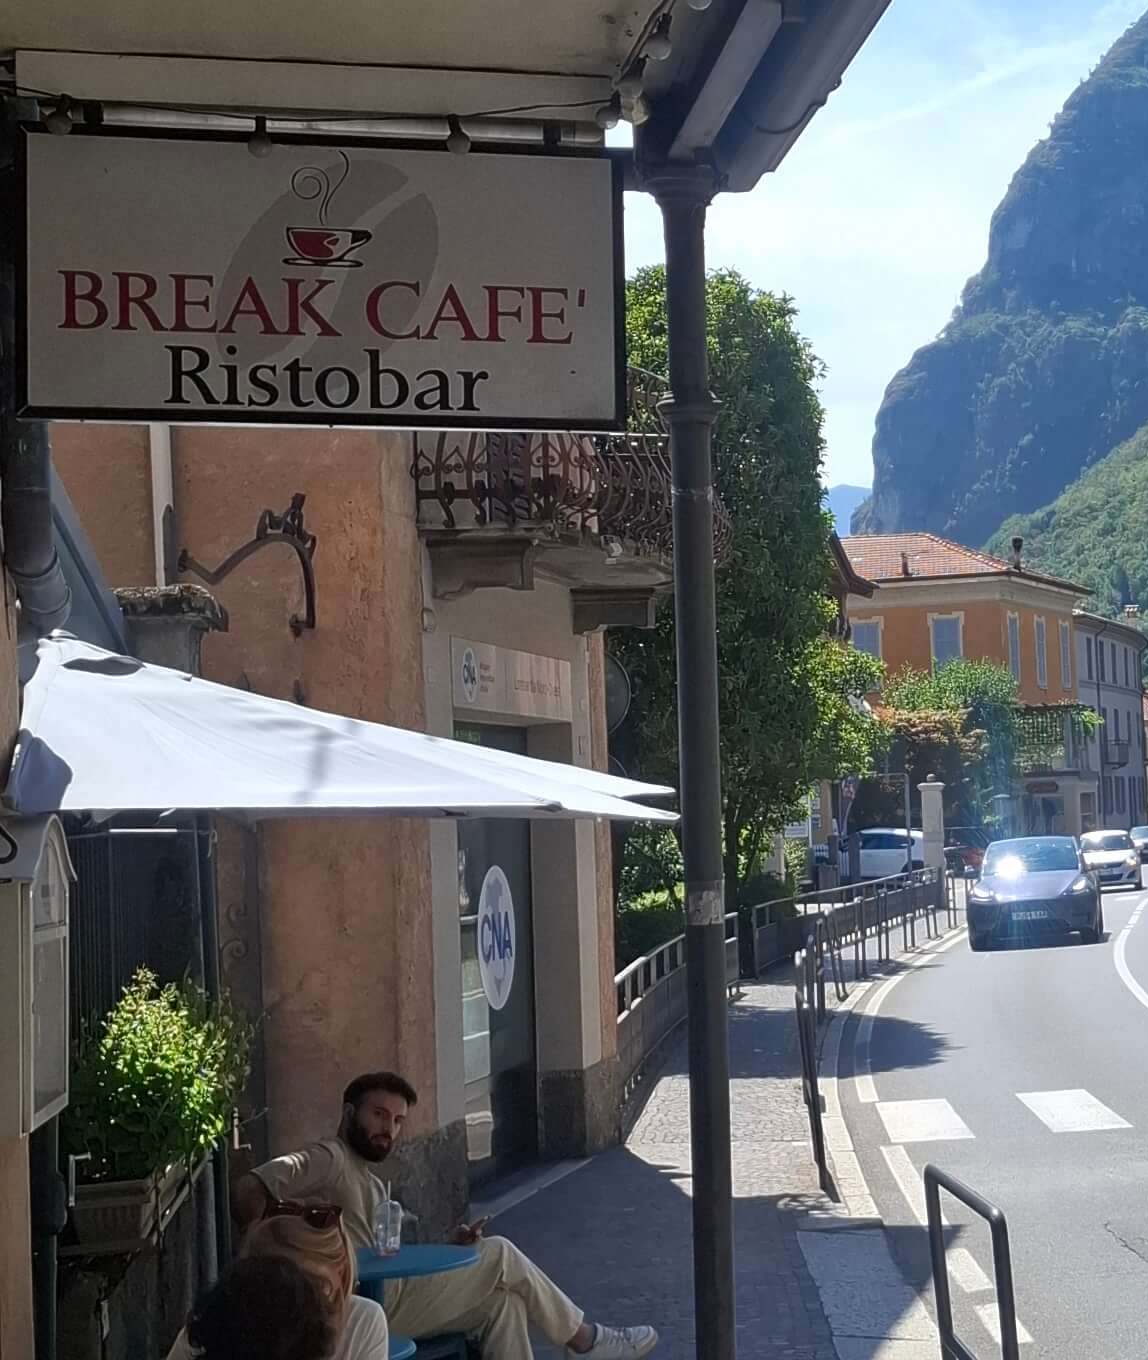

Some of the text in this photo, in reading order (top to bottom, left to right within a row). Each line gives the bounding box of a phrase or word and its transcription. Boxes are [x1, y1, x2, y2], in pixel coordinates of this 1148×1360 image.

[56, 269, 588, 345] BREAK CAFE'
[162, 344, 489, 412] Ristobar
[463, 662, 478, 686] CNA
[480, 911, 513, 964] CNA
